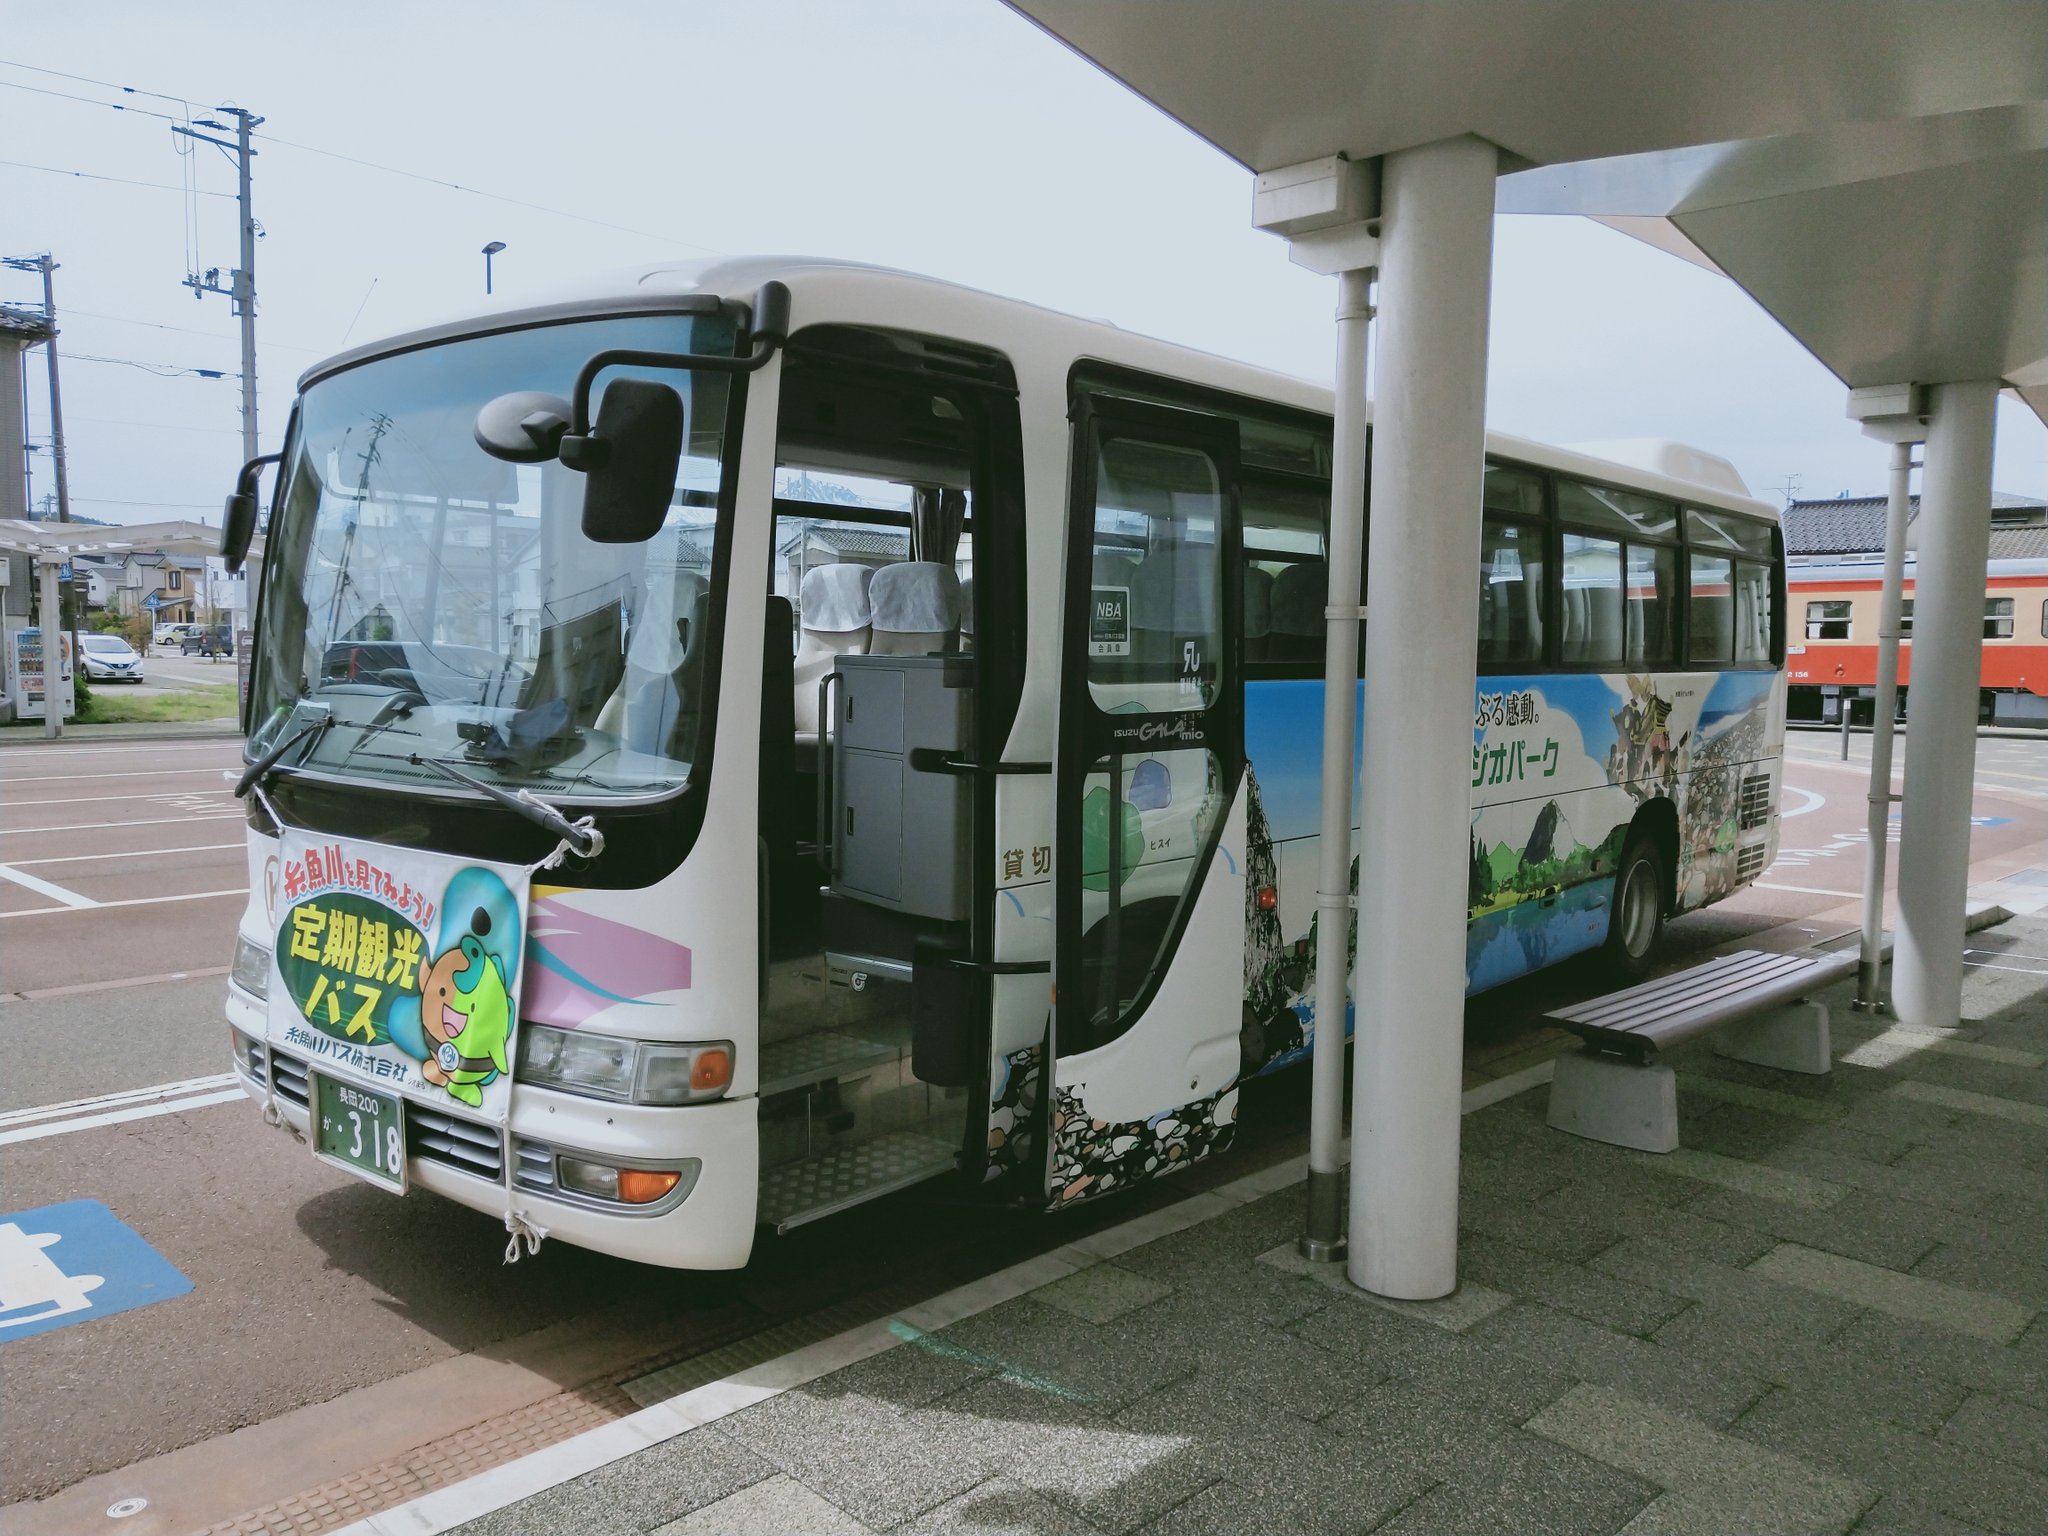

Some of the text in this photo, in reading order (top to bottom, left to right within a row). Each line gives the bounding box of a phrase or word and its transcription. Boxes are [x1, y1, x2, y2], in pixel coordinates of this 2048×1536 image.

[1096, 602, 1122, 617] NBA
[1475, 693, 1540, 727] ぶる感動。
[1114, 728, 1139, 738] ISUZU
[1138, 720, 1187, 741] GALA
[1472, 737, 1559, 787] ジオパーク
[1150, 838, 1171, 850] ヒスイ
[1003, 846, 1051, 881] 貸切
[291, 903, 422, 990] 定期観光
[304, 974, 382, 1043] バス
[284, 1026, 408, 1082] 糸魚川バス株式会社
